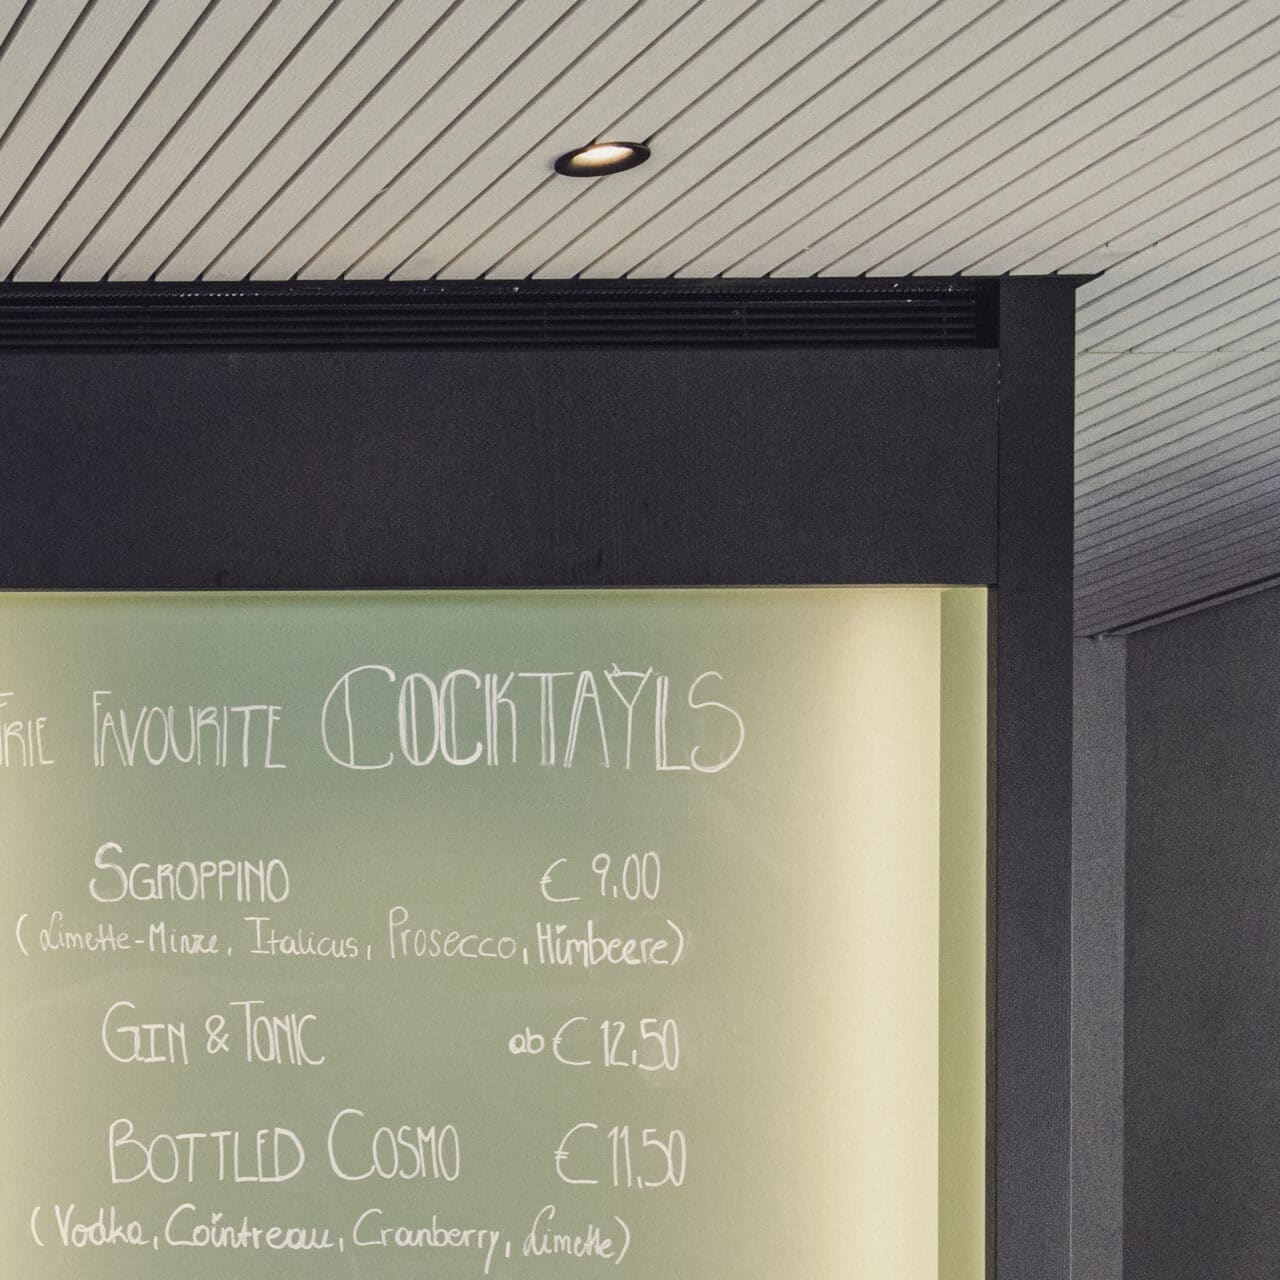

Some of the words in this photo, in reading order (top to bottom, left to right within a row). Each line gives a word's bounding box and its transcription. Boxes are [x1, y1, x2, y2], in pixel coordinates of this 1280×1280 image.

[92, 690, 288, 770] FAVOURITE
[320, 662, 746, 775] COCKTAYLS
[89, 841, 290, 903] SGROPPINO
[389, 905, 529, 965] Prosecco,
[101, 1000, 190, 1066] GIN
[204, 1013, 230, 1055] &
[229, 999, 326, 1067] TONIC
[508, 1025, 546, 1055] ab
[108, 1117, 306, 1185] BOTTLED
[327, 1107, 461, 1182] COSMO
